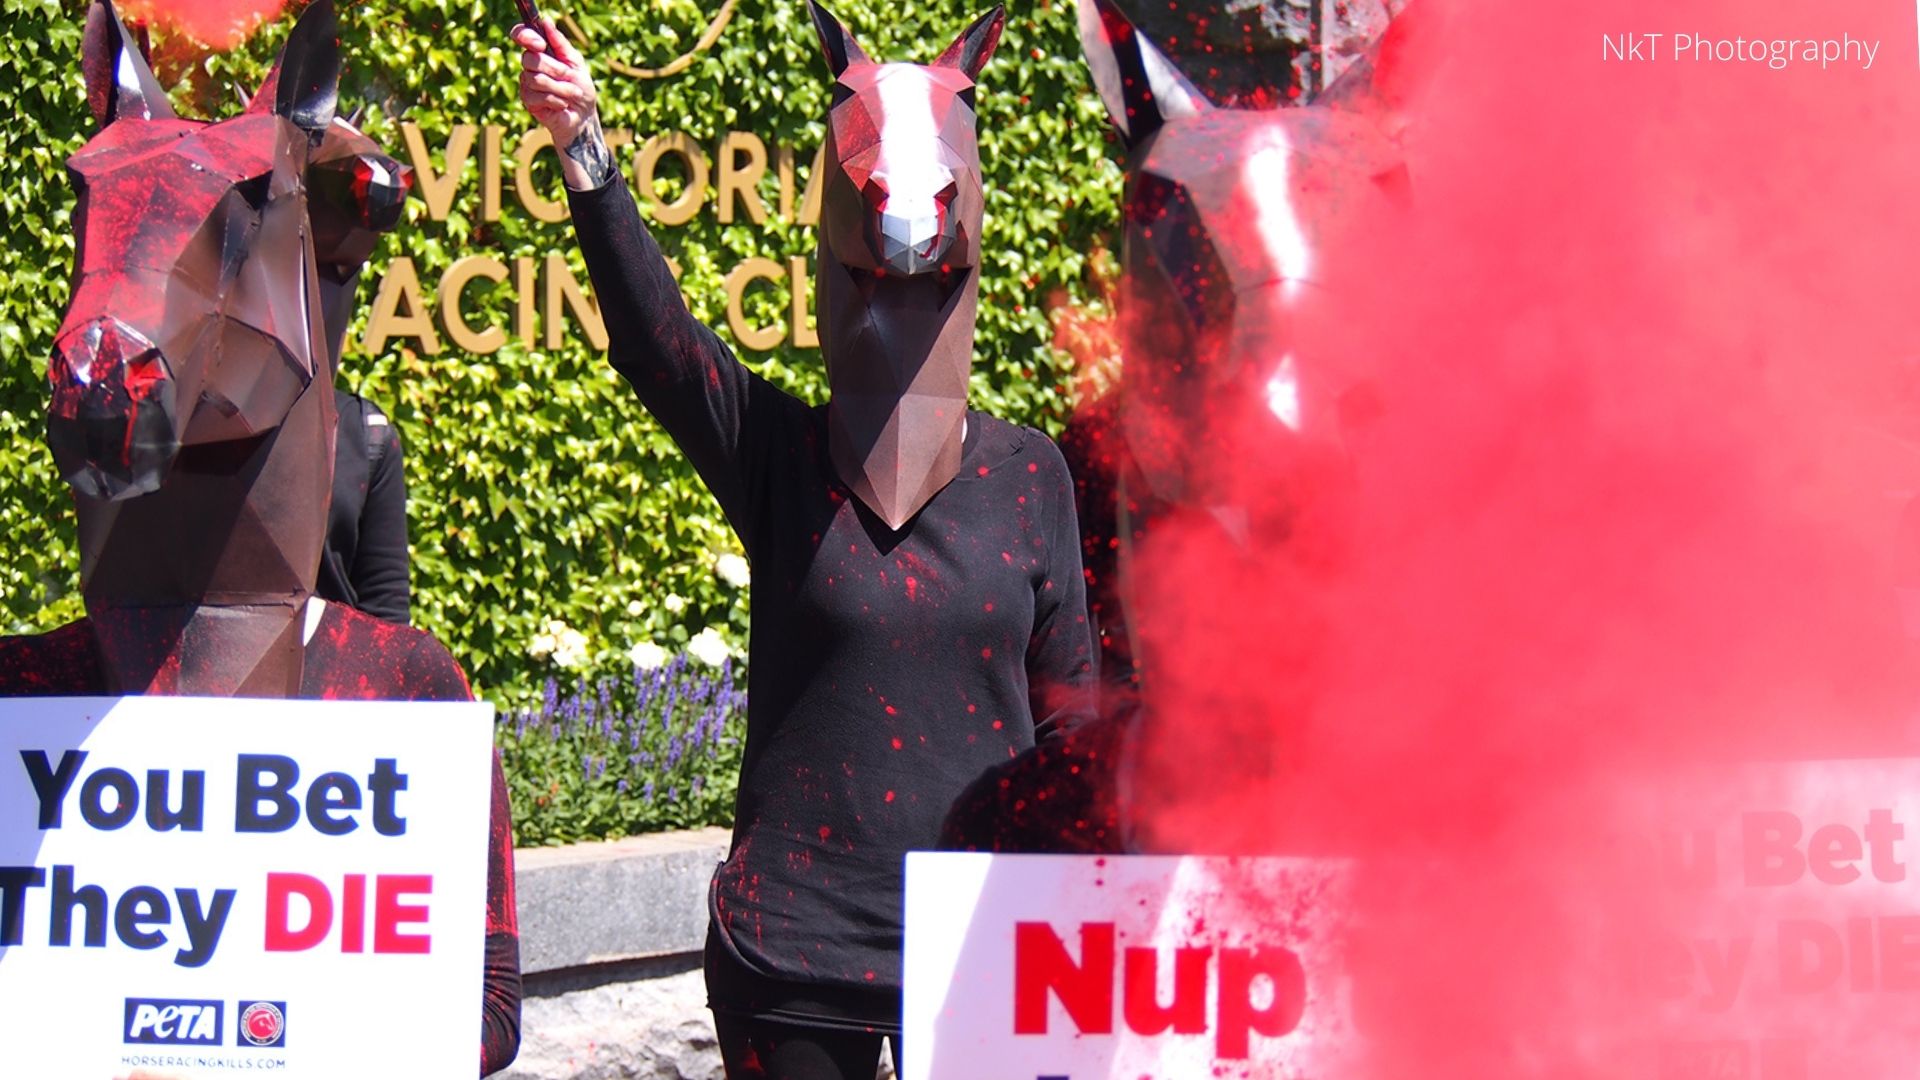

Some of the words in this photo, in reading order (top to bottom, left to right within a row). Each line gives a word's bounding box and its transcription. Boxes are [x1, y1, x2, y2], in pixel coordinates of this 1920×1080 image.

[361, 255, 690, 355] ACIN
[19, 749, 206, 832] You
[235, 753, 409, 837] Bet
[1741, 808, 1907, 888] Bet
[0, 864, 238, 969] They
[263, 871, 434, 955] DIE
[1777, 915, 1920, 995] DIE
[1013, 921, 1307, 1060] Nup
[121, 1056, 286, 1070] HORSERACINGKILLS.COM
